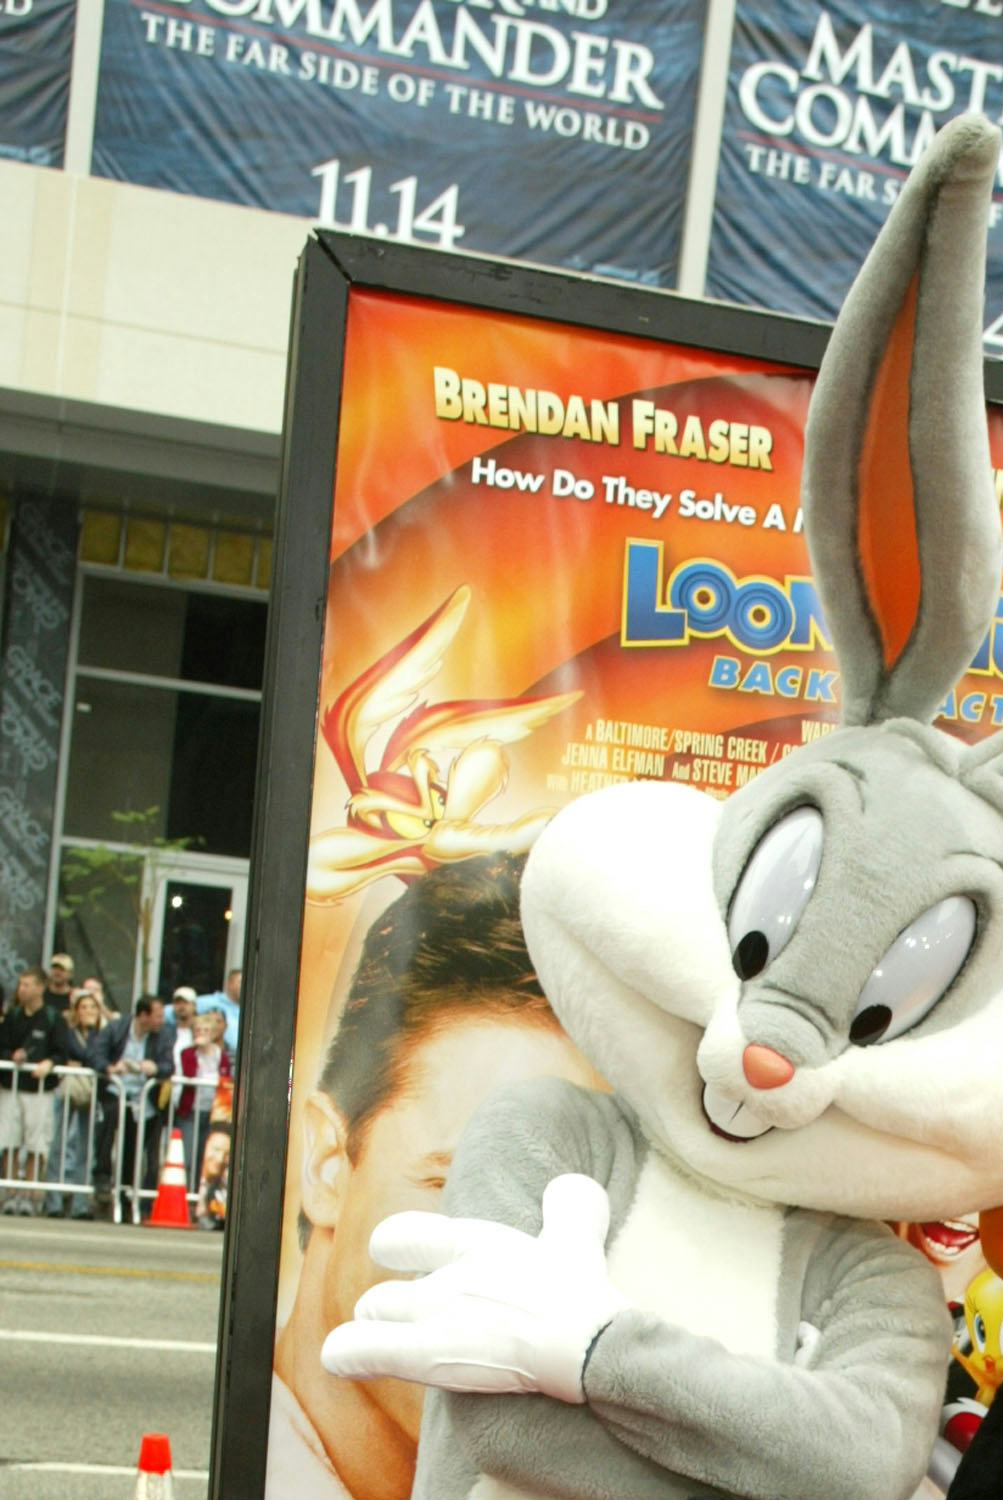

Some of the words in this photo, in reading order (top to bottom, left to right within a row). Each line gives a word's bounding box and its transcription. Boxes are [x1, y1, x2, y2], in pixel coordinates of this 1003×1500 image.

[141, 12, 215, 56] THE
[226, 34, 290, 75] FAR
[299, 51, 379, 96] SIDE
[387, 73, 435, 107] OF
[445, 84, 515, 124] THE
[525, 101, 650, 150] WORLD
[310, 158, 466, 247] 11.14
[745, 143, 811, 185] THE
[819, 163, 877, 201] FAR
[433, 366, 620, 447] BRENDAN
[631, 399, 774, 472] FRASER
[471, 457, 545, 493] How
[552, 470, 594, 501] Do
[602, 476, 671, 519] They
[679, 490, 756, 527] Solve
[763, 504, 786, 531] A
[708, 656, 841, 702] BACK
[562, 743, 607, 769] JENNA
[612, 748, 666, 777] ELFMAN
[693, 759, 732, 786] STEVE
[727, 736, 768, 764] CREEK
